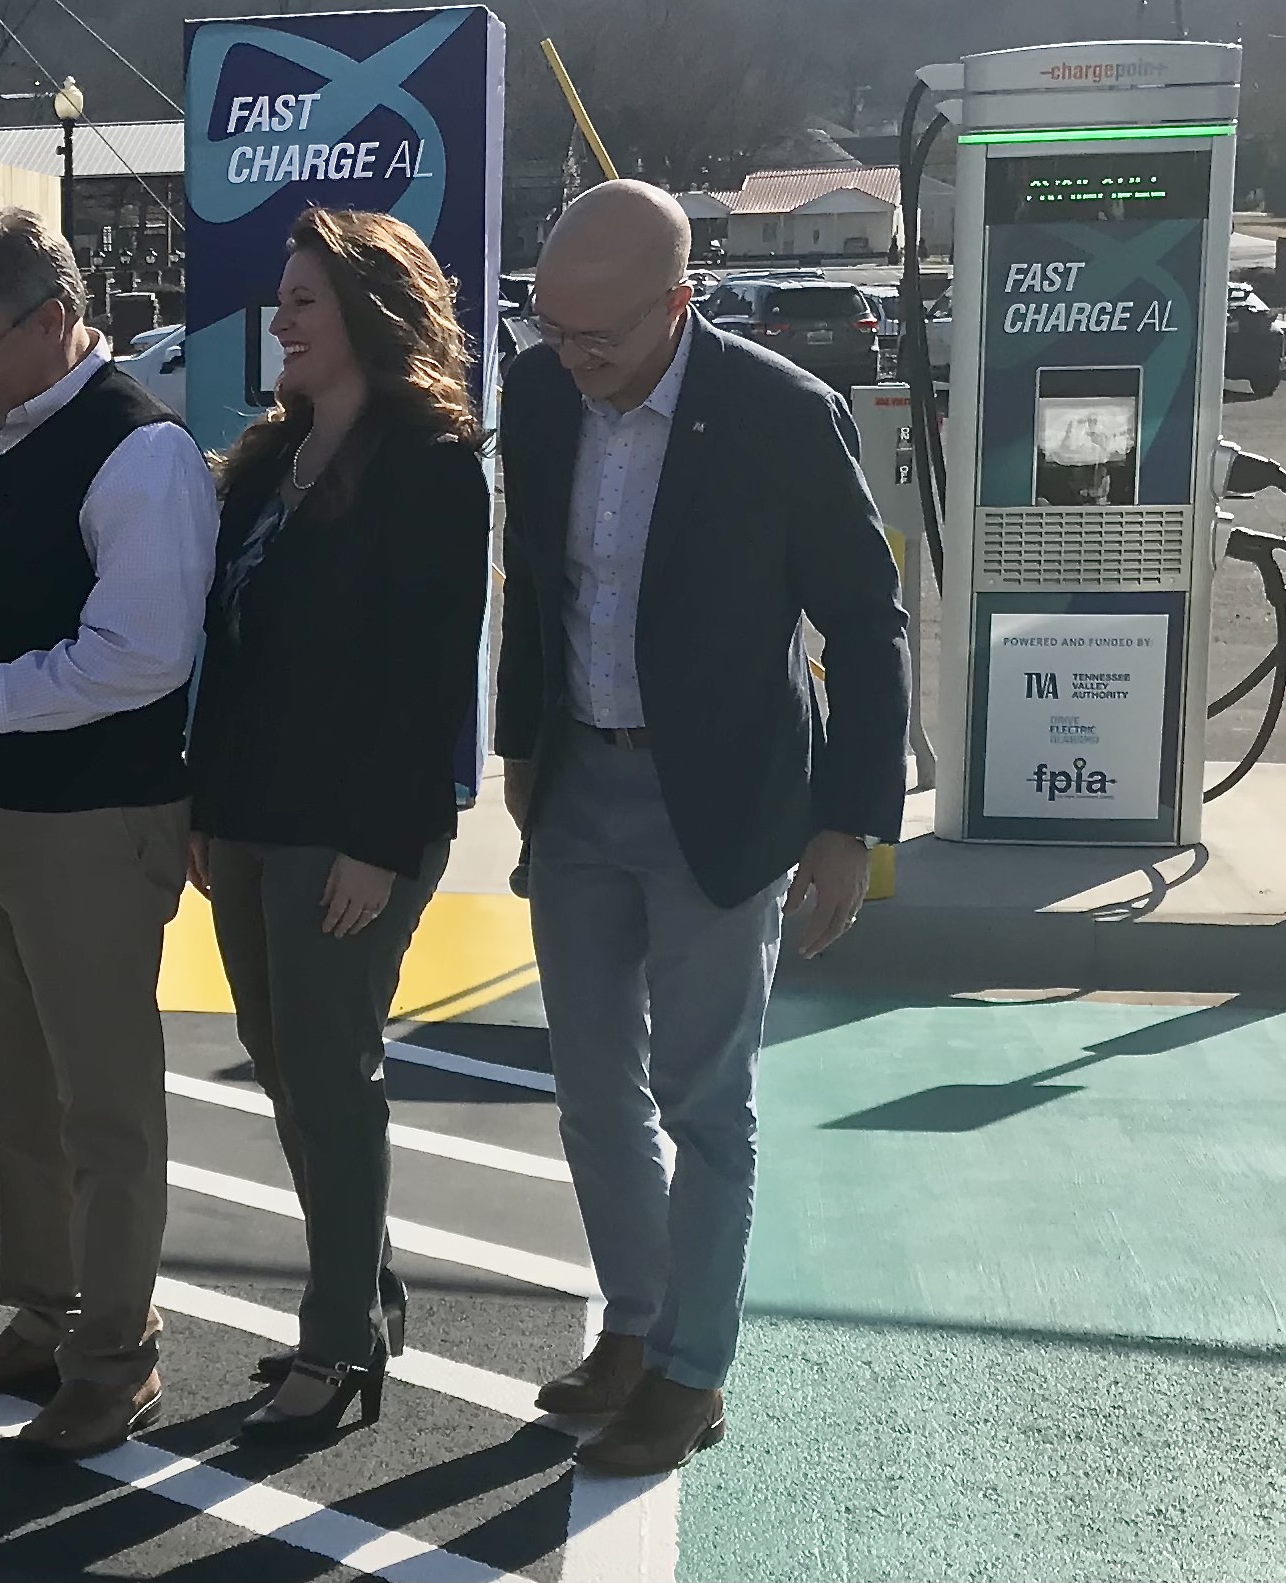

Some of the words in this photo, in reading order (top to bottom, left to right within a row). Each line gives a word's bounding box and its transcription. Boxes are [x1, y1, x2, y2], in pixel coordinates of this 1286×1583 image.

[227, 93, 321, 134] FAST
[227, 141, 380, 184] CHARGE
[385, 138, 433, 179] AL
[1004, 261, 1086, 294] FAST
[1003, 300, 1134, 334] CHARGE
[1136, 299, 1179, 332] AL
[1003, 637, 1058, 648] POWERED
[1061, 637, 1086, 648] AND
[1089, 637, 1134, 648] FUNDED
[1024, 672, 1060, 700] TVA
[1071, 673, 1131, 682] TENNESSEE
[1071, 682, 1109, 690] VALLEY
[1071, 691, 1130, 700] AUTHORITY
[1032, 757, 1110, 802] fpia
